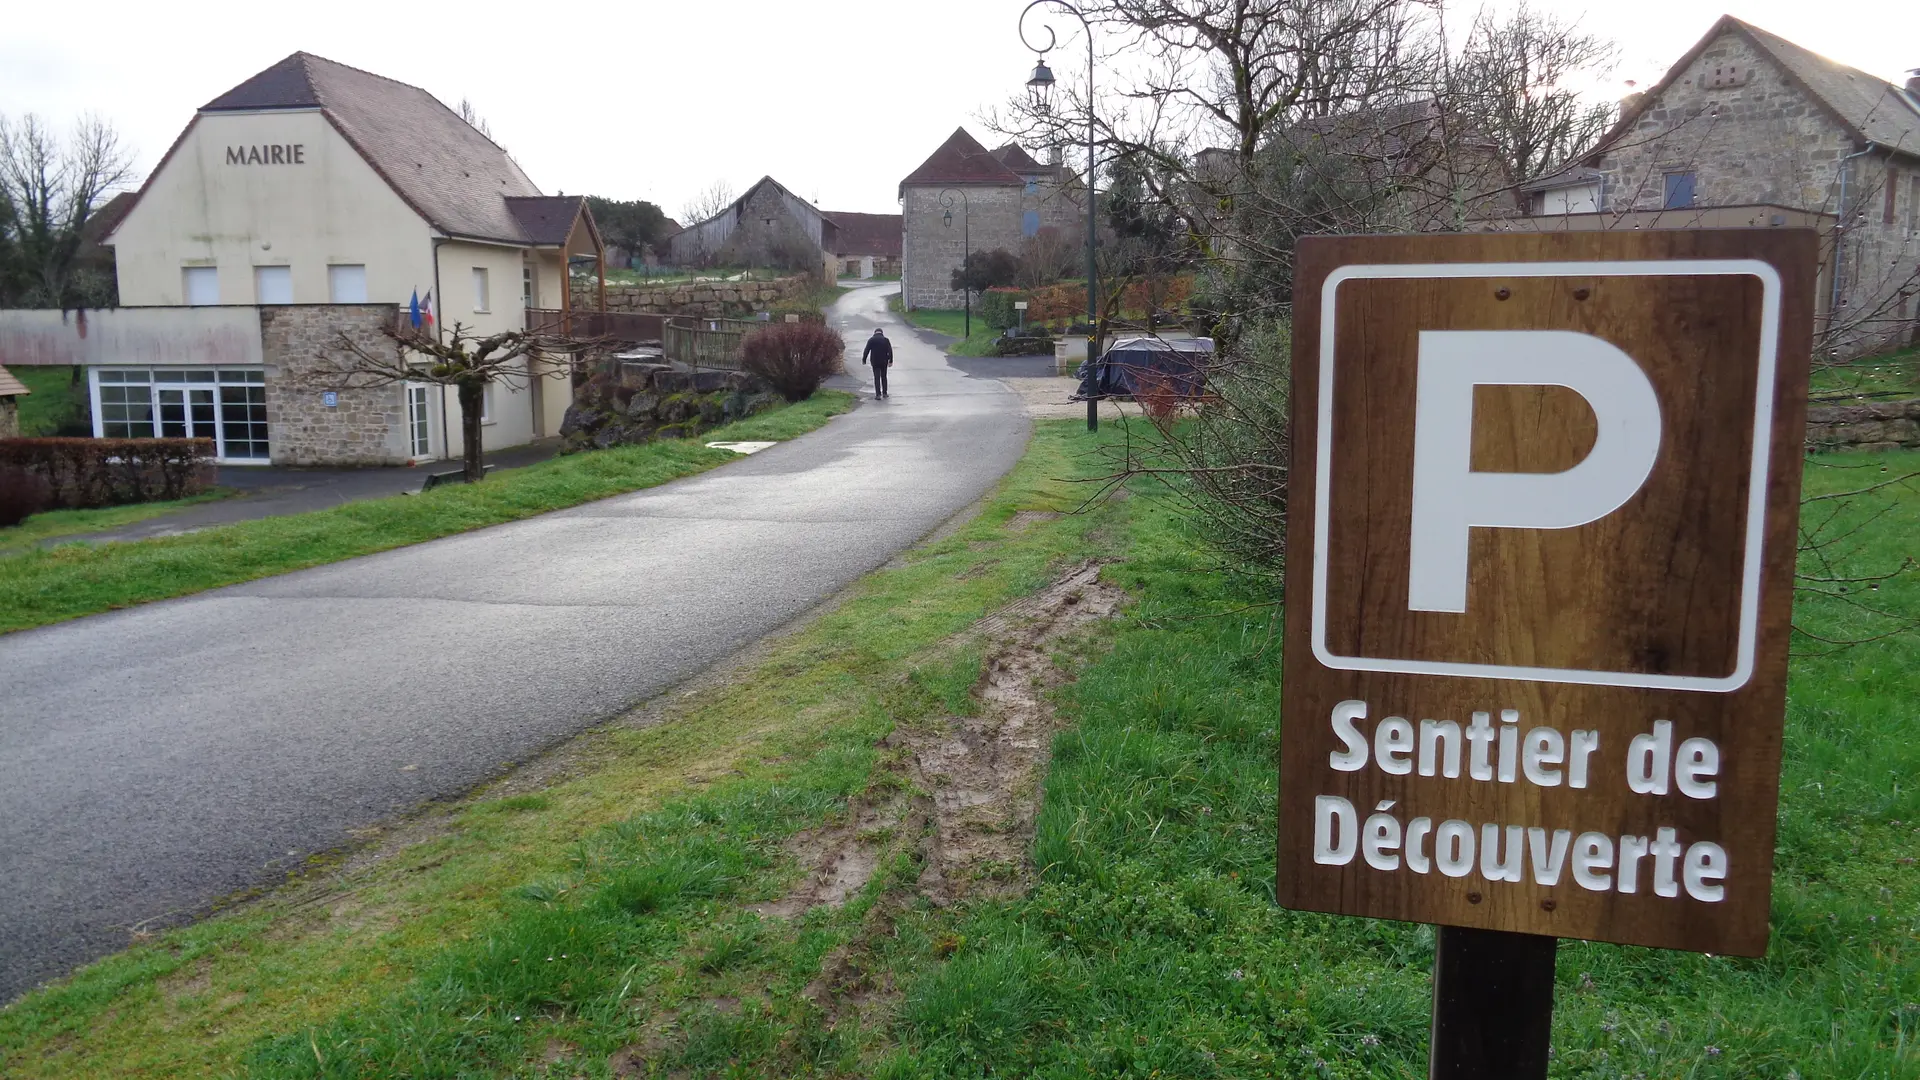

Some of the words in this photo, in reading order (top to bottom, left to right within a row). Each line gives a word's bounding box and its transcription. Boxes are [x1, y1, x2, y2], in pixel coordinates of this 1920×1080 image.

[226, 144, 304, 165] MAIRIE
[1408, 330, 1661, 614] P
[1329, 700, 1598, 789] Sentier
[1626, 719, 1719, 799] de
[1313, 795, 1727, 903] Découverte
